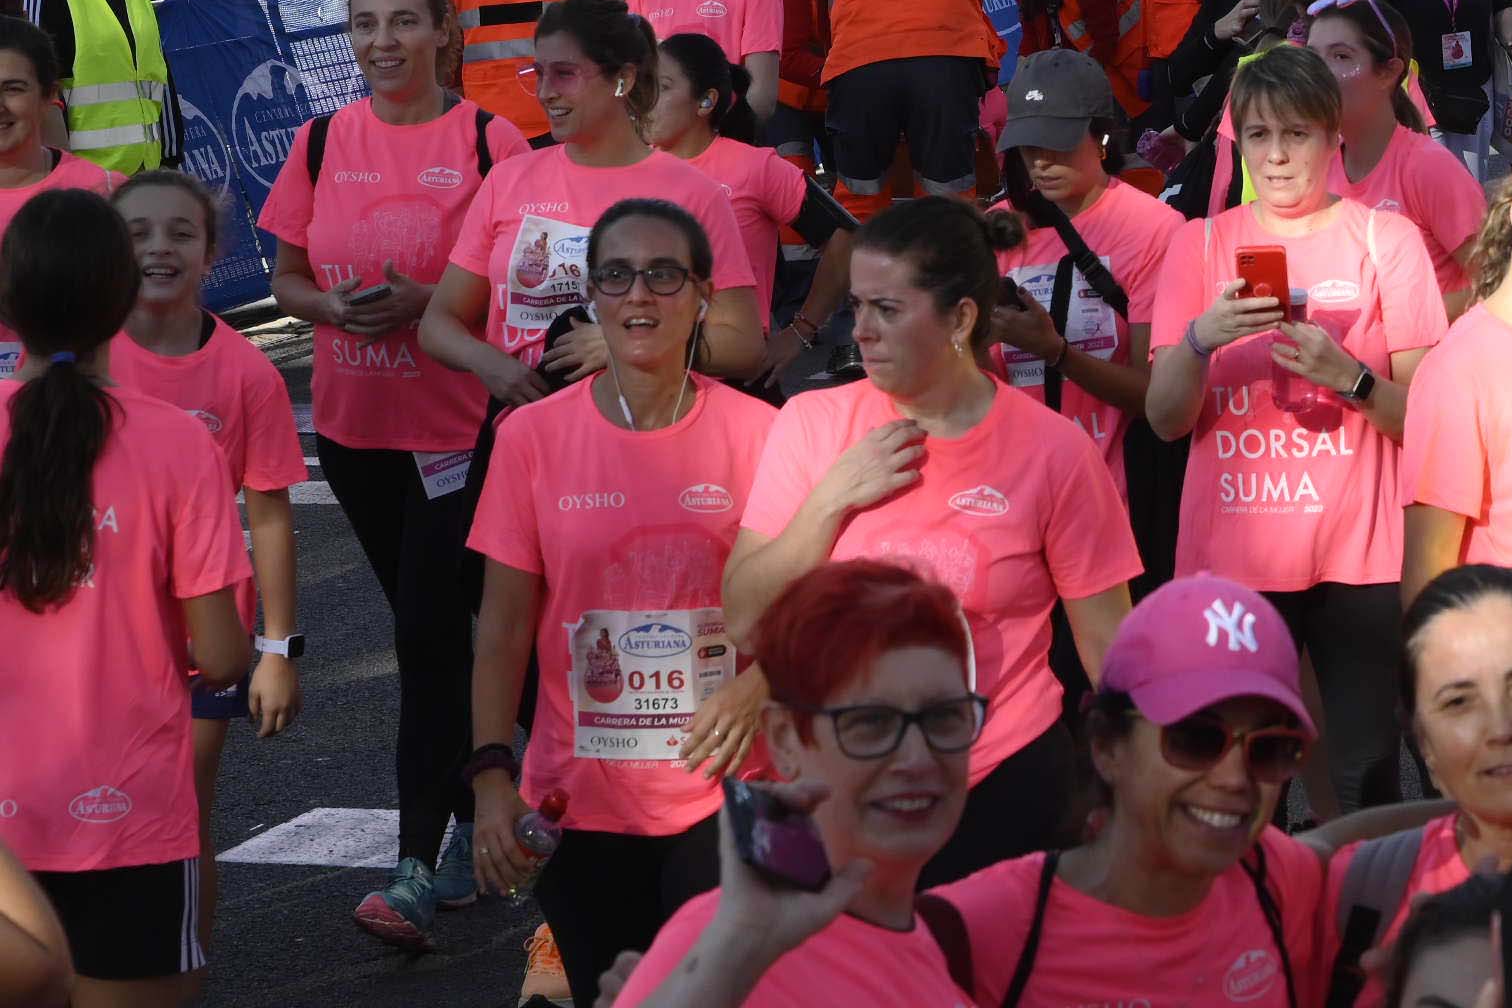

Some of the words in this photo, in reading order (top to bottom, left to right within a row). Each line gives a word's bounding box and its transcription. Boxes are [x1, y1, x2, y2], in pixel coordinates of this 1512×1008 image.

[518, 201, 570, 215] OYSHO
[550, 280, 579, 293] 1715
[331, 338, 416, 369] SUMA
[1212, 385, 1250, 417] TU
[1215, 425, 1354, 461] DORSAL
[1219, 470, 1320, 504] SUMA
[558, 491, 626, 511] OYSHO
[622, 633, 689, 651] ASTURIANA
[627, 669, 685, 691] 016
[633, 697, 679, 711] 31673
[593, 715, 637, 726] CARRERA
[638, 715, 652, 725] DE
[654, 715, 667, 725] LA
[589, 735, 638, 750] OYSHO
